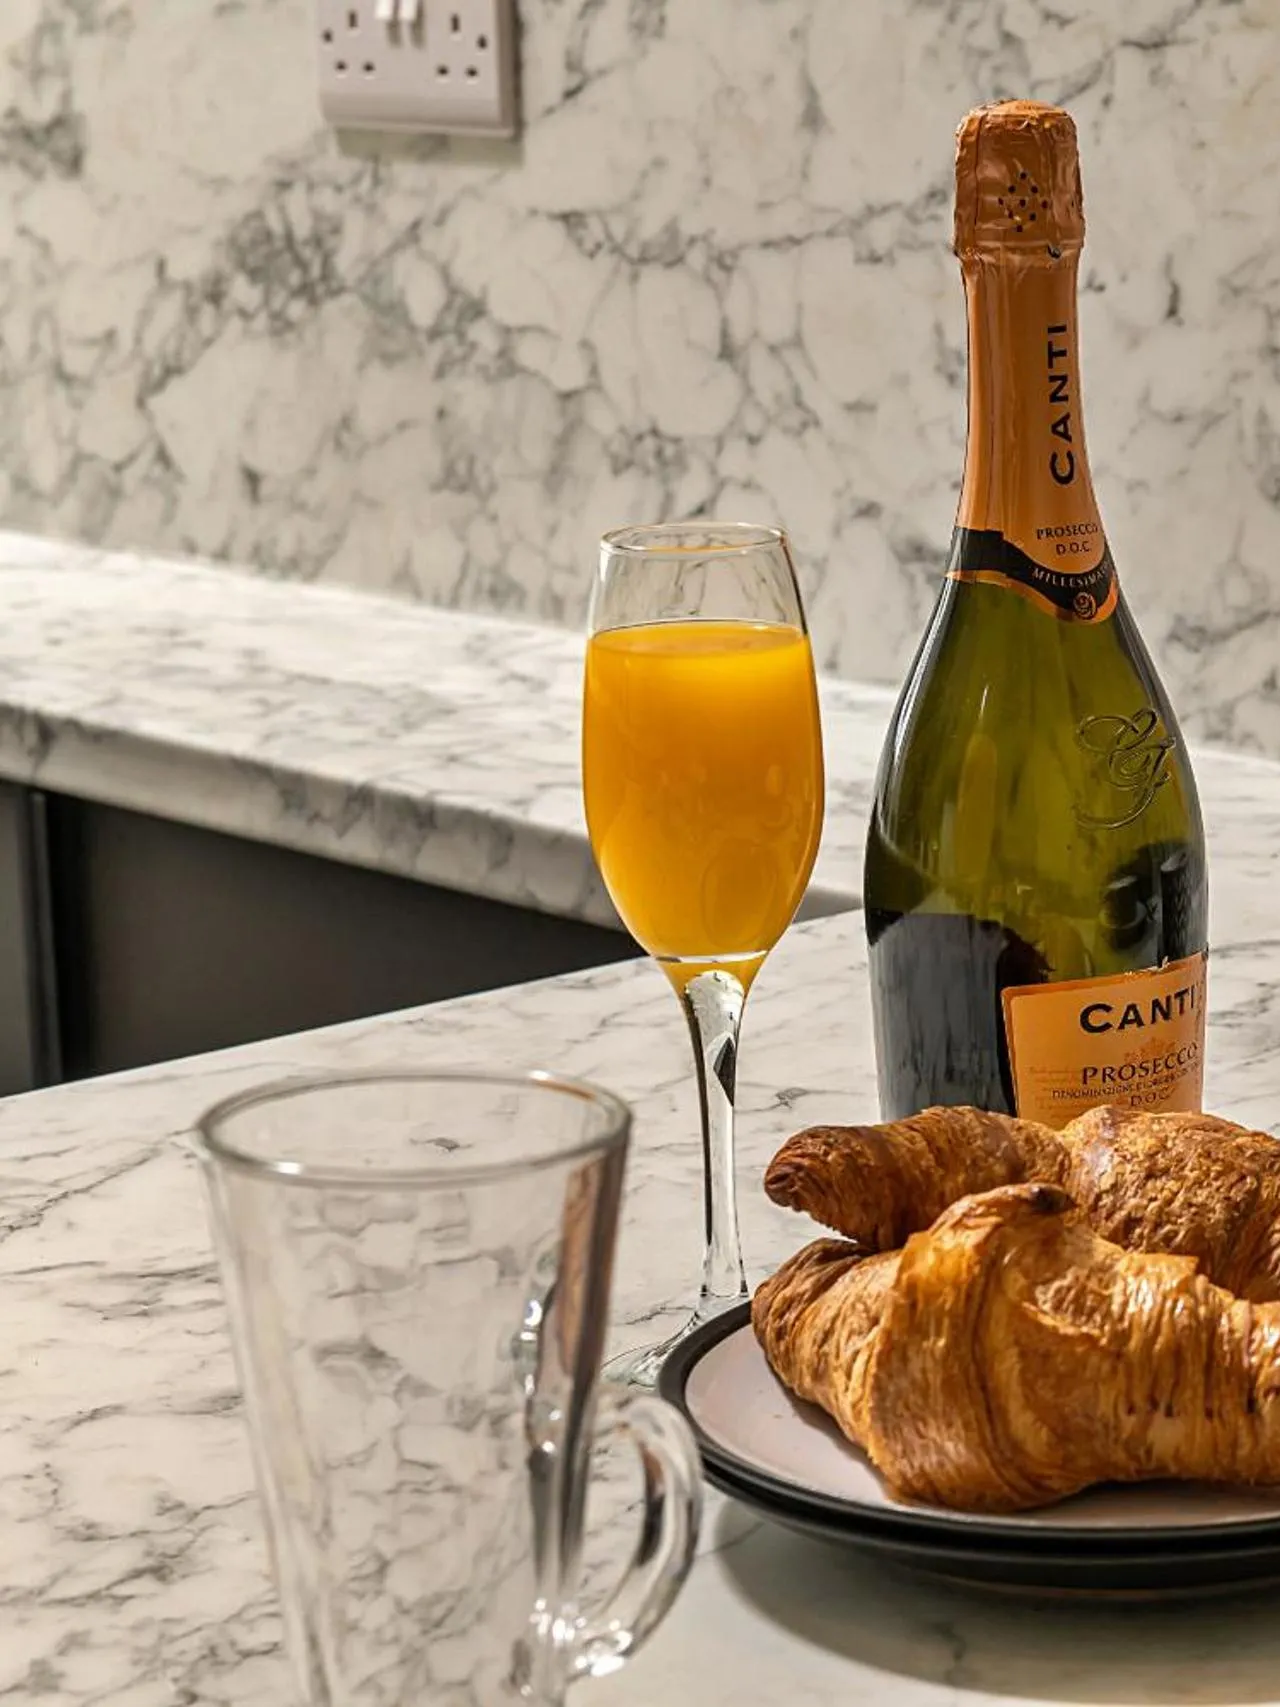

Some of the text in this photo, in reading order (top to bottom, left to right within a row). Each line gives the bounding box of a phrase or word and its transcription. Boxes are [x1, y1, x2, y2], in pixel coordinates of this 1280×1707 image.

[1047, 324, 1075, 485] CANTI
[1036, 523, 1098, 541] PROSECCO
[1079, 984, 1195, 1034] CANTI
[1082, 1043, 1198, 1085] PROSECCO
